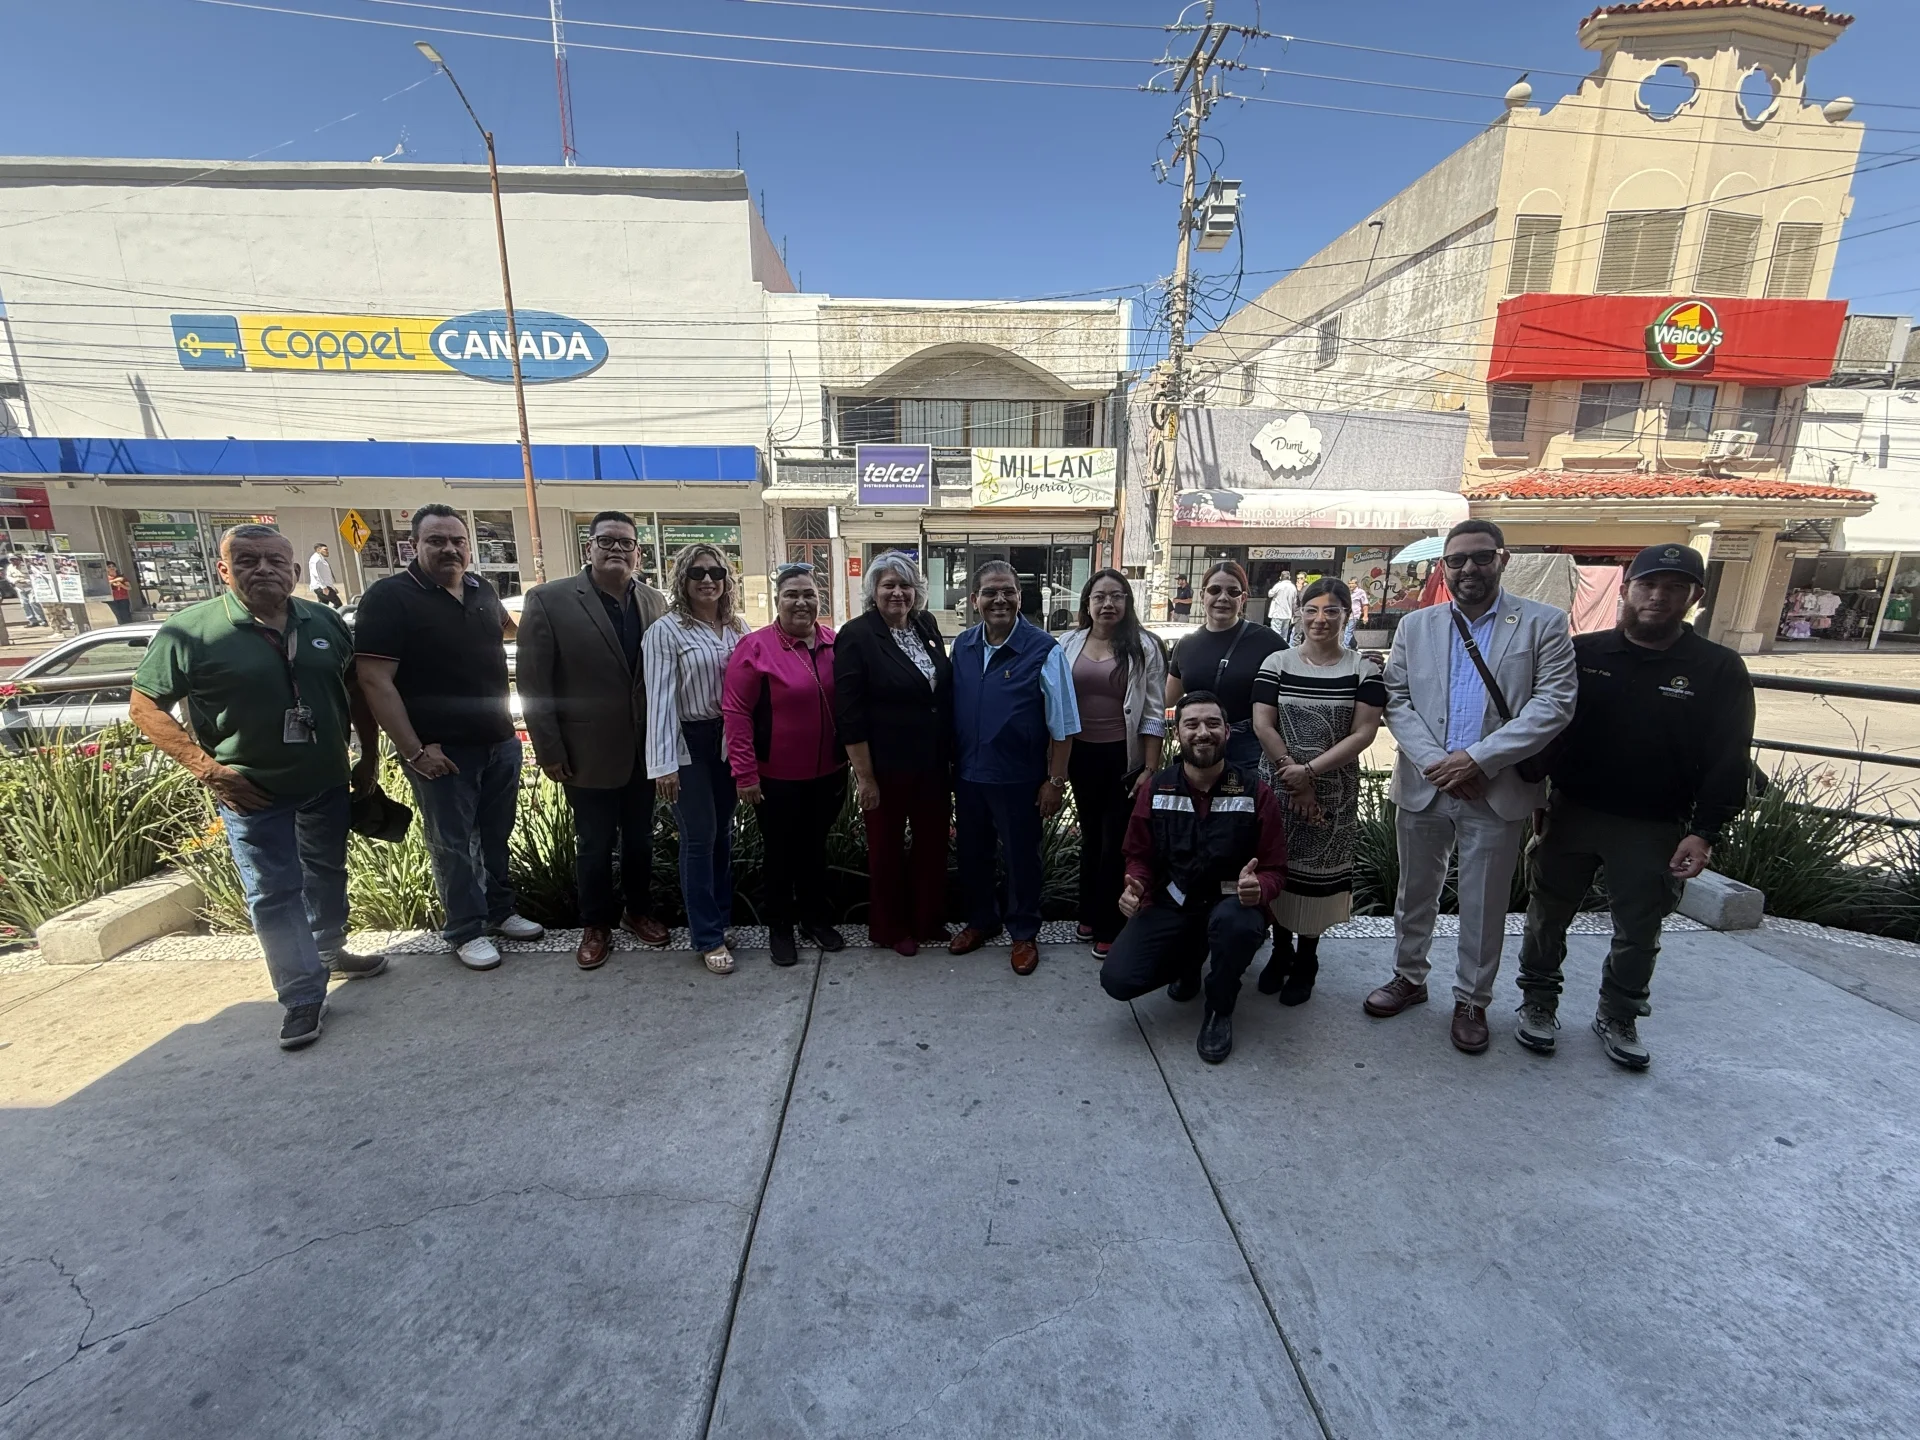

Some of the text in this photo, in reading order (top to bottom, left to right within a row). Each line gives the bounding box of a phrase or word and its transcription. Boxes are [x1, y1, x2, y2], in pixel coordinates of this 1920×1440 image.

[438, 329, 593, 360] CANADA
[1654, 325, 1723, 346] Waldo's
[261, 325, 415, 370] Coppel
[1271, 436, 1308, 454] Dumi
[863, 463, 925, 482] telcel
[1000, 455, 1093, 478] MILLAN
[1015, 476, 1075, 499] Joyeria's
[1229, 508, 1327, 519] CENTRO DULCERO
[1335, 510, 1400, 529] DUMI
[1243, 519, 1311, 528] DE NOGALES
[1265, 548, 1319, 560] Bienvenidos
